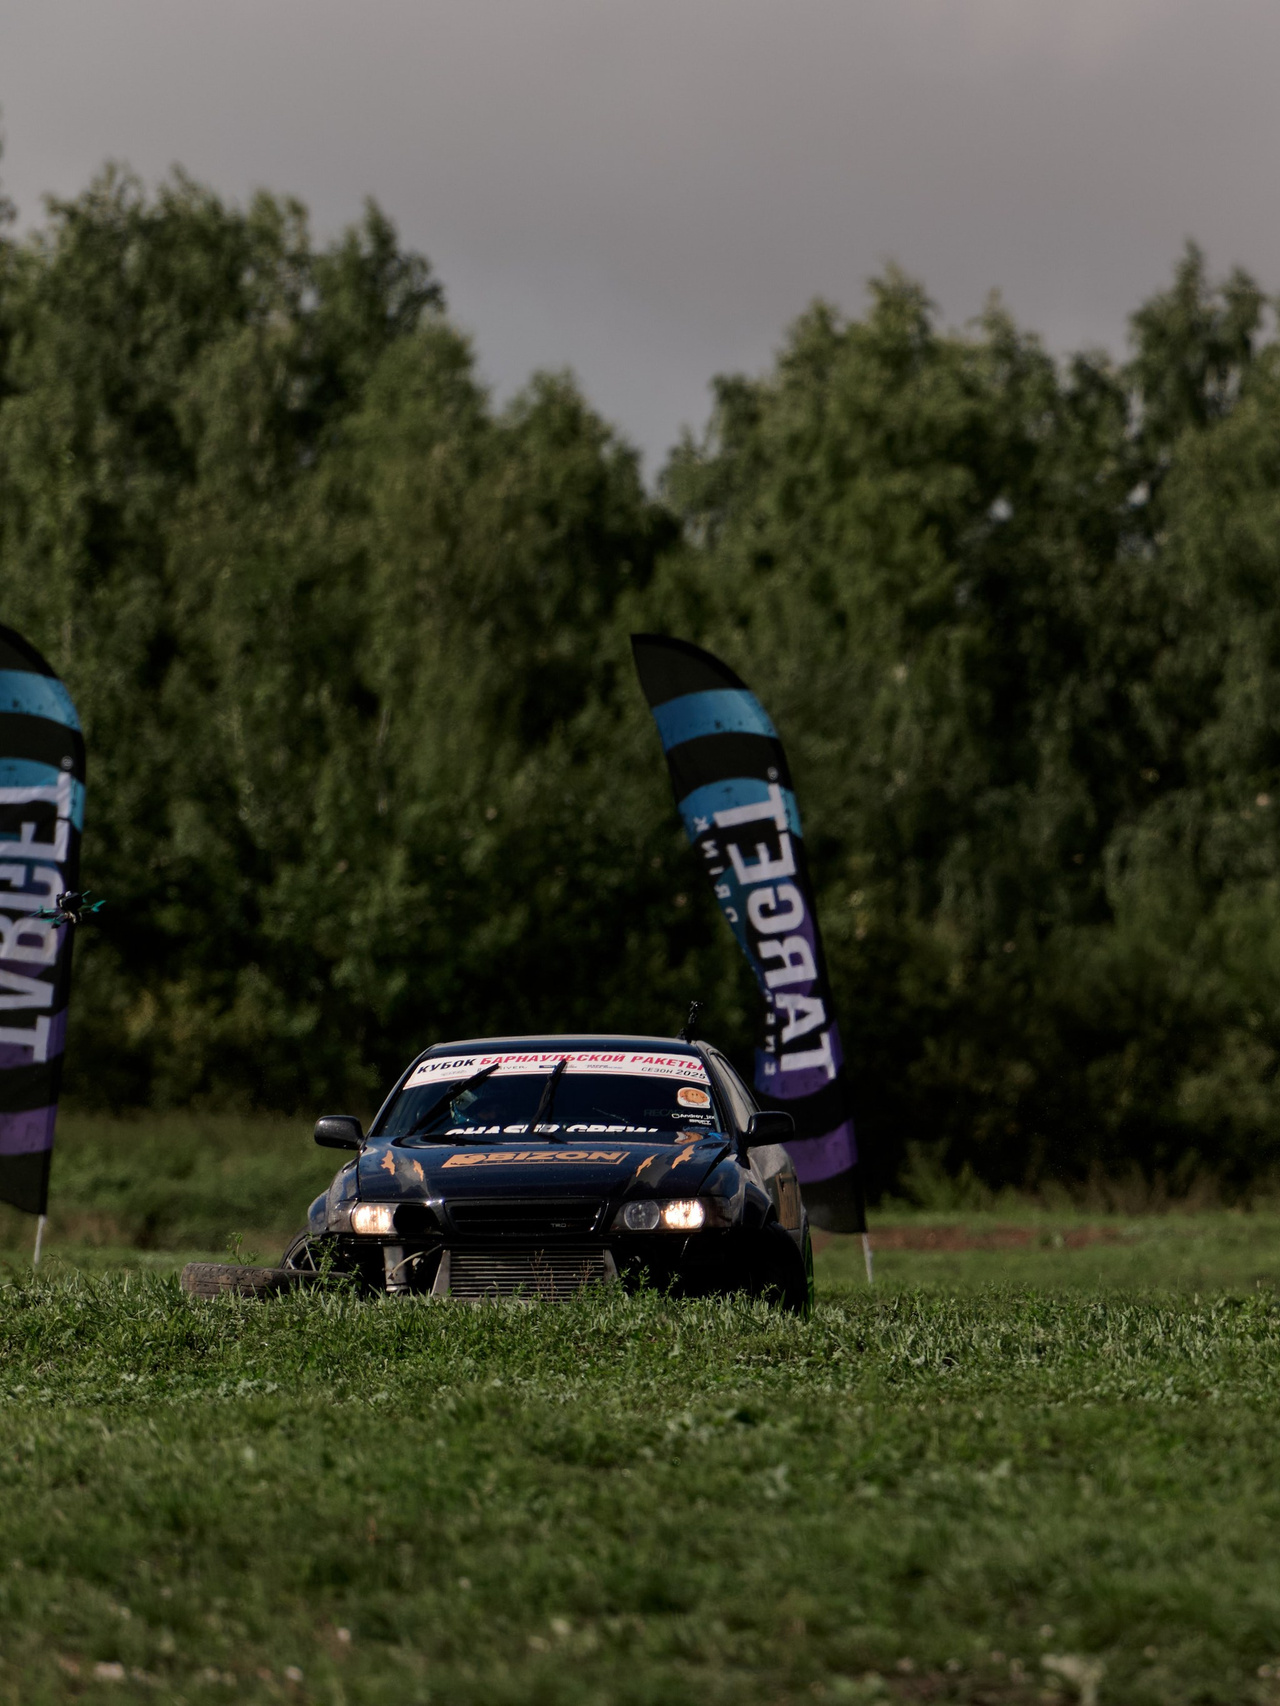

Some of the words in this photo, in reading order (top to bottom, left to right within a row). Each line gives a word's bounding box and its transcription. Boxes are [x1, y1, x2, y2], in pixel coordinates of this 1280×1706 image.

[417, 1058, 476, 1074] КУБОК
[480, 1053, 626, 1066] БАРНАУЛЬСКОЙ
[631, 1055, 705, 1072] РАКЕТЫ
[675, 1068, 707, 1080] 2025
[485, 1151, 619, 1162] BIZON
